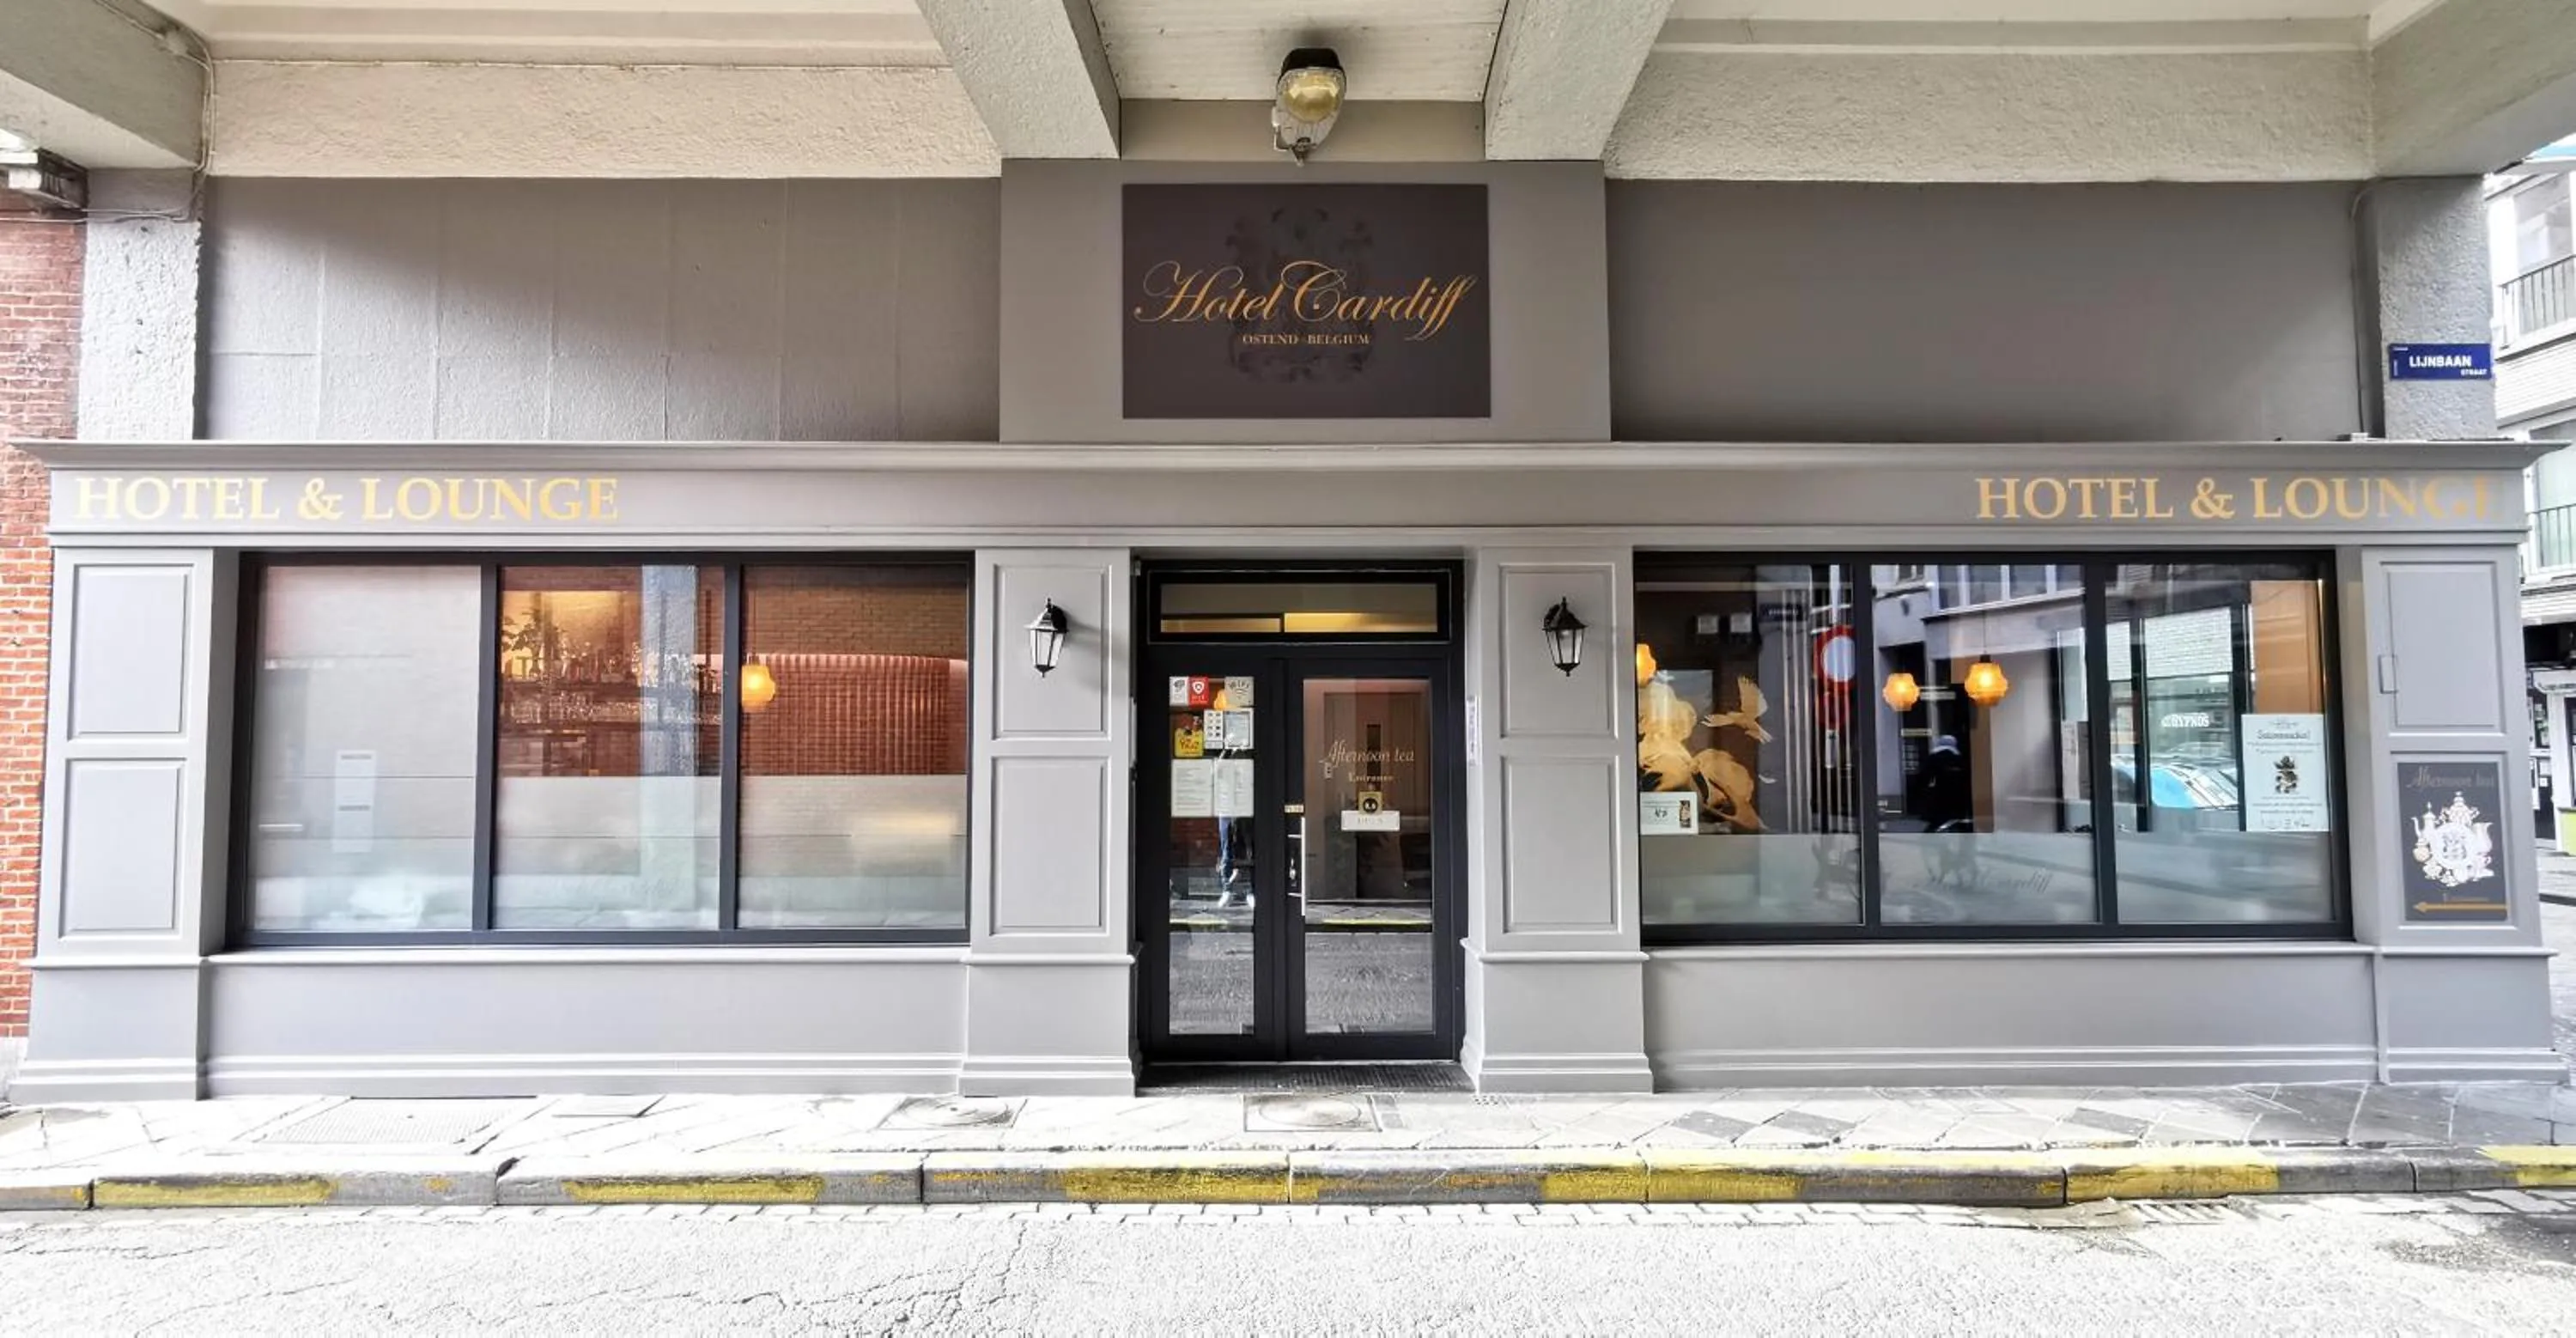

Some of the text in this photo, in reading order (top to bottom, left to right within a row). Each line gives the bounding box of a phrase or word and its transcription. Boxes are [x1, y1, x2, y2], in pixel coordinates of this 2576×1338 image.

[1133, 260, 1477, 341] Hotel Cardiff
[1242, 332, 1371, 344] OSTEND BELGIUM
[2409, 355, 2472, 368] LIJNBAAN
[76, 477, 619, 521] HOTEL & LOUNGE
[1975, 477, 2174, 520] HOTEL
[2190, 477, 2235, 520] &
[1319, 739, 1391, 768] Afternoon
